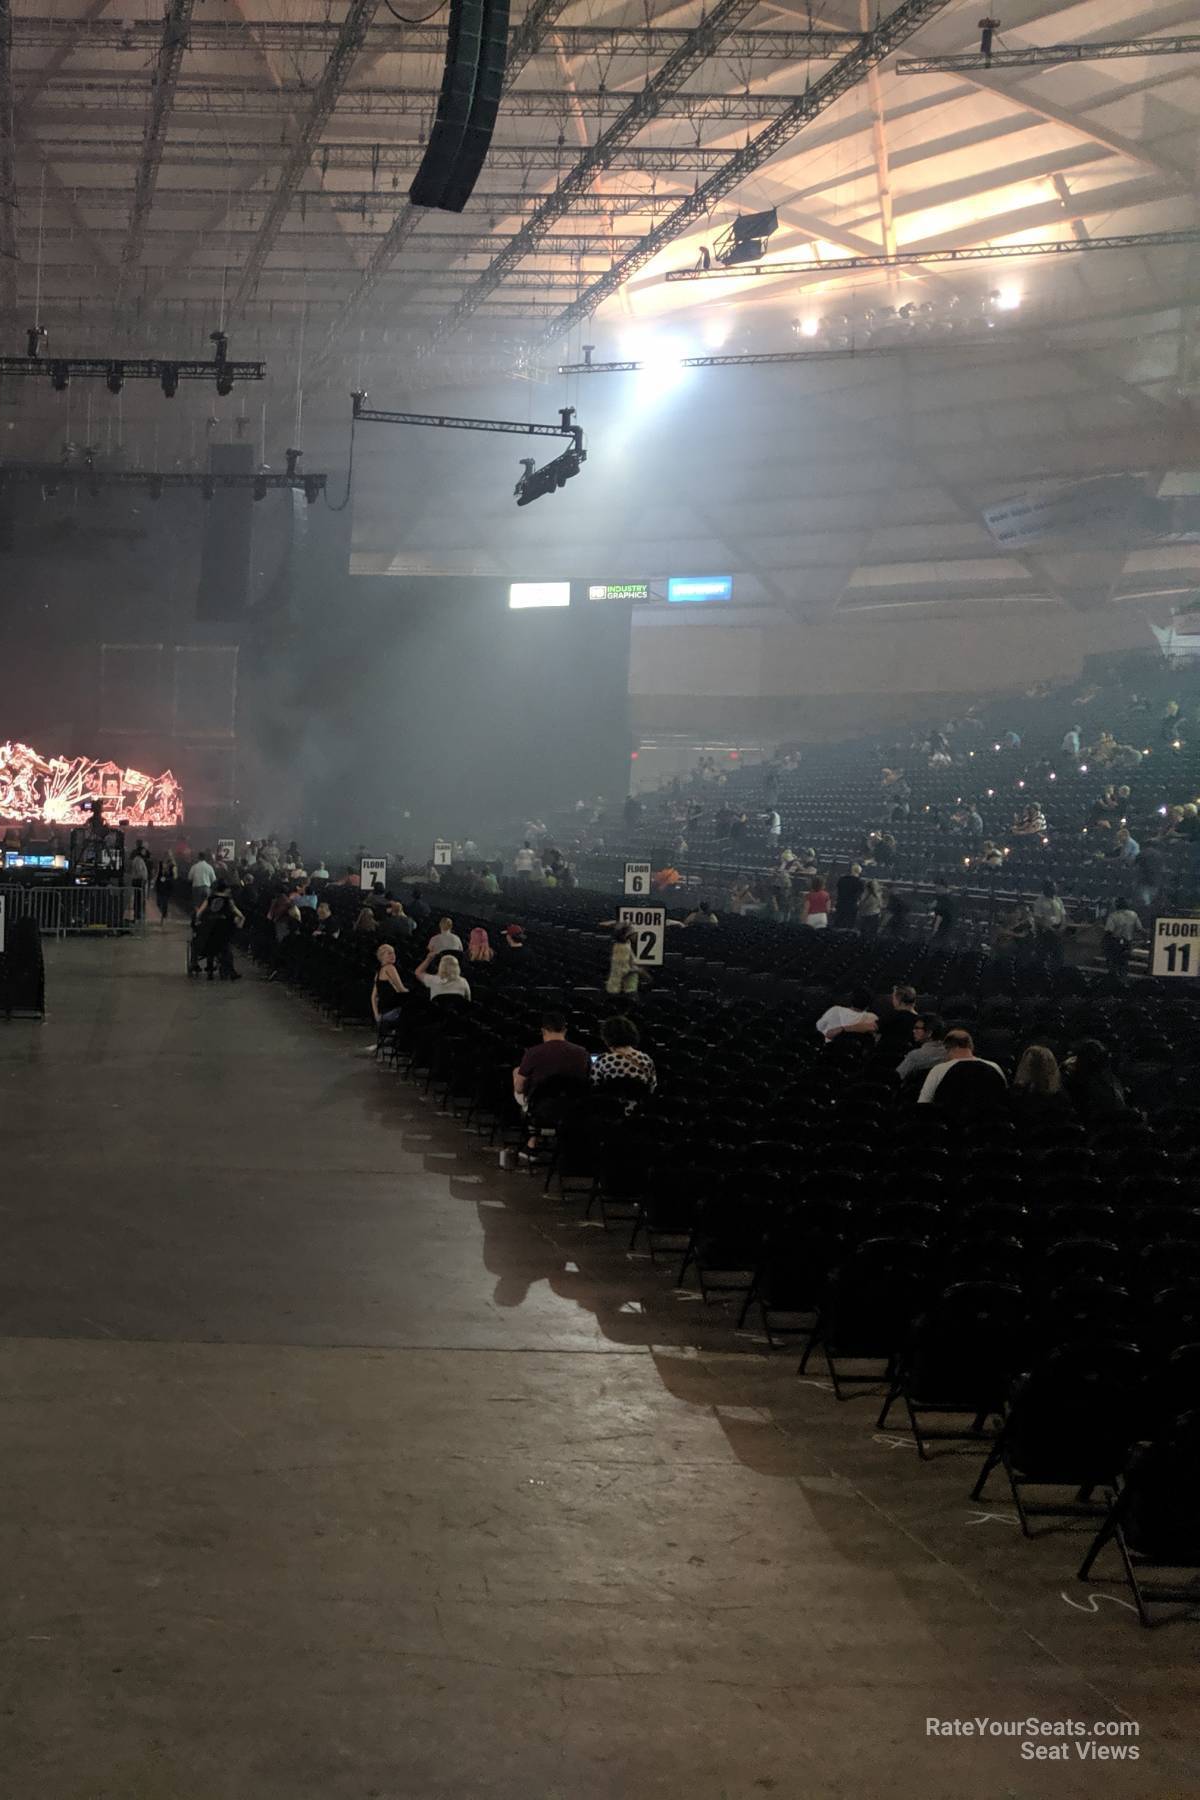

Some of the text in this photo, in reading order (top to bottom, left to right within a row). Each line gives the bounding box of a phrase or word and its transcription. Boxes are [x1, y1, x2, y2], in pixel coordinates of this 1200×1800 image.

[223, 848, 230, 858] 2
[440, 852, 446, 863] 1
[363, 861, 385, 869] FLOOR
[369, 871, 378, 887] 7
[633, 876, 643, 891] 6
[622, 911, 662, 926] FLOOR
[1158, 922, 1198, 937] FLOOR
[1163, 943, 1191, 972] 11
